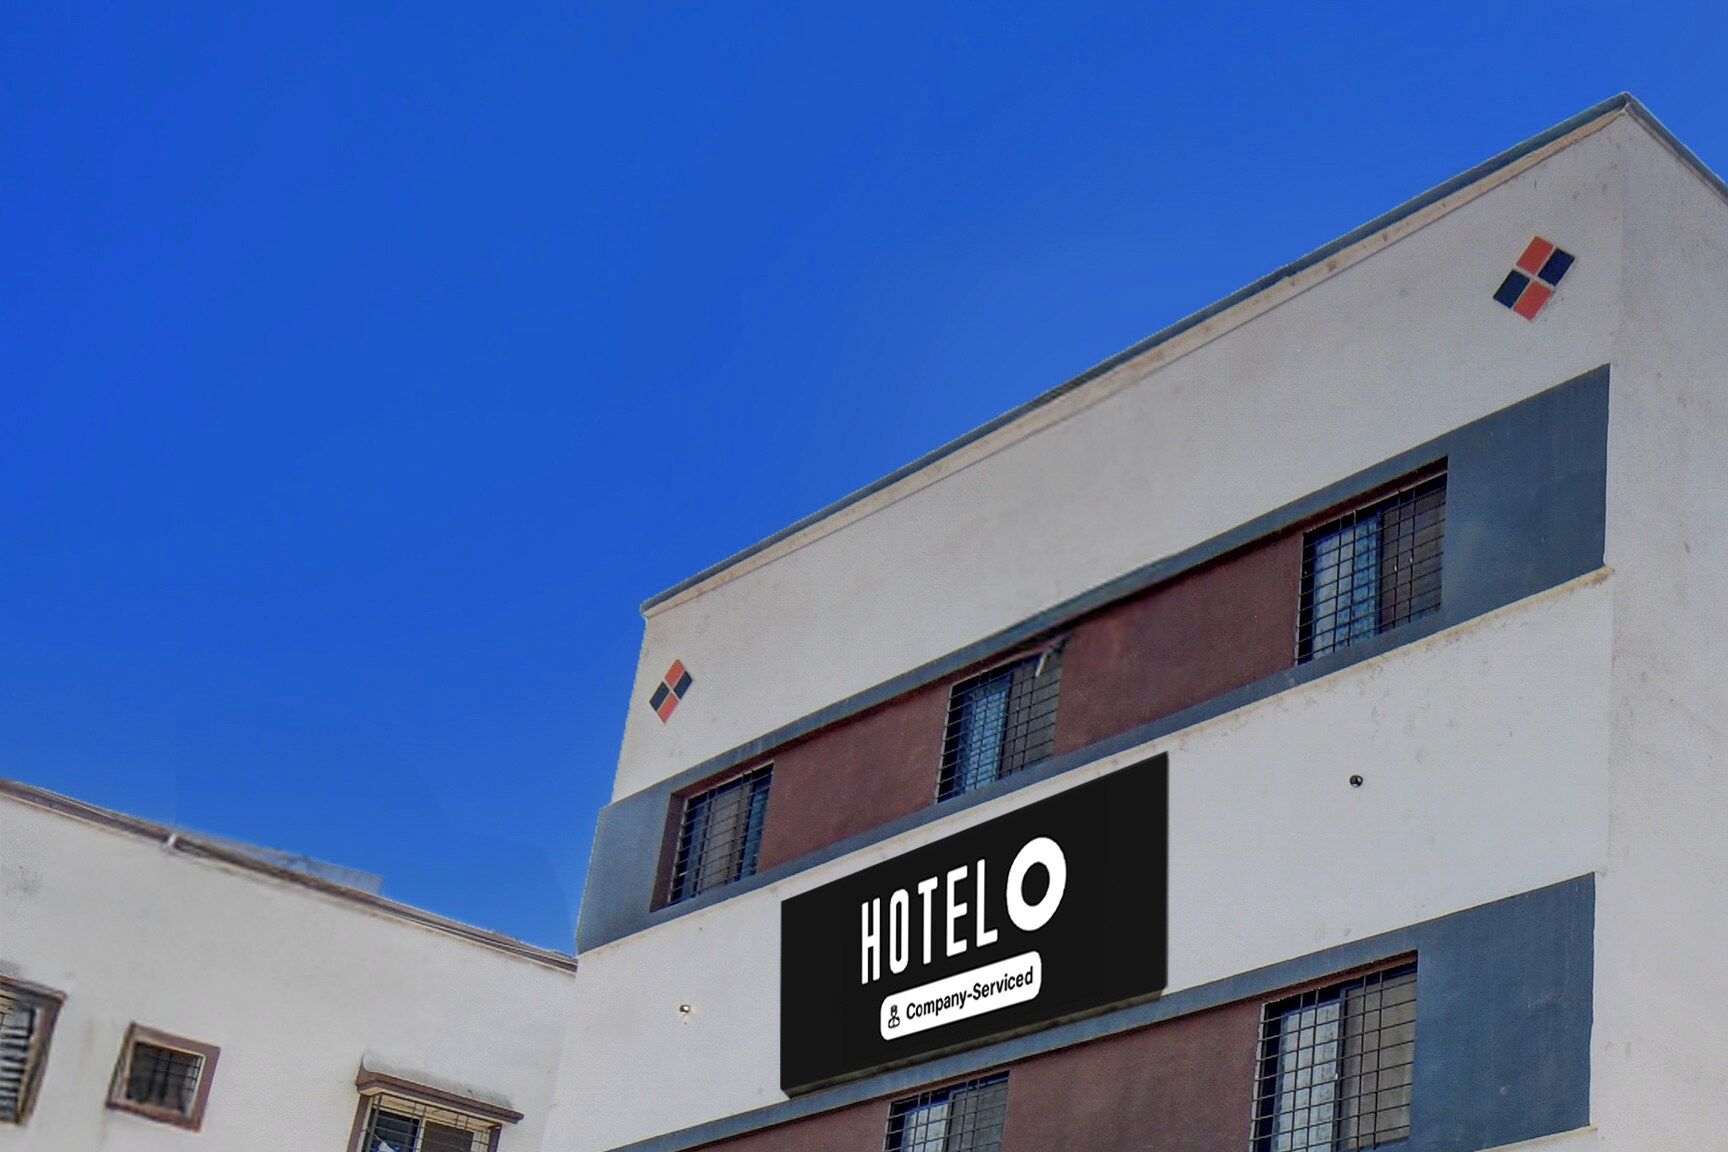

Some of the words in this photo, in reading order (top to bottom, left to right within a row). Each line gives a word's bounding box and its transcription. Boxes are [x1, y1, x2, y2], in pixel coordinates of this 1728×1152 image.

[861, 858, 998, 985] HOTEL
[1006, 836, 1067, 932] O
[906, 965, 1034, 1020] Company-Serviced
